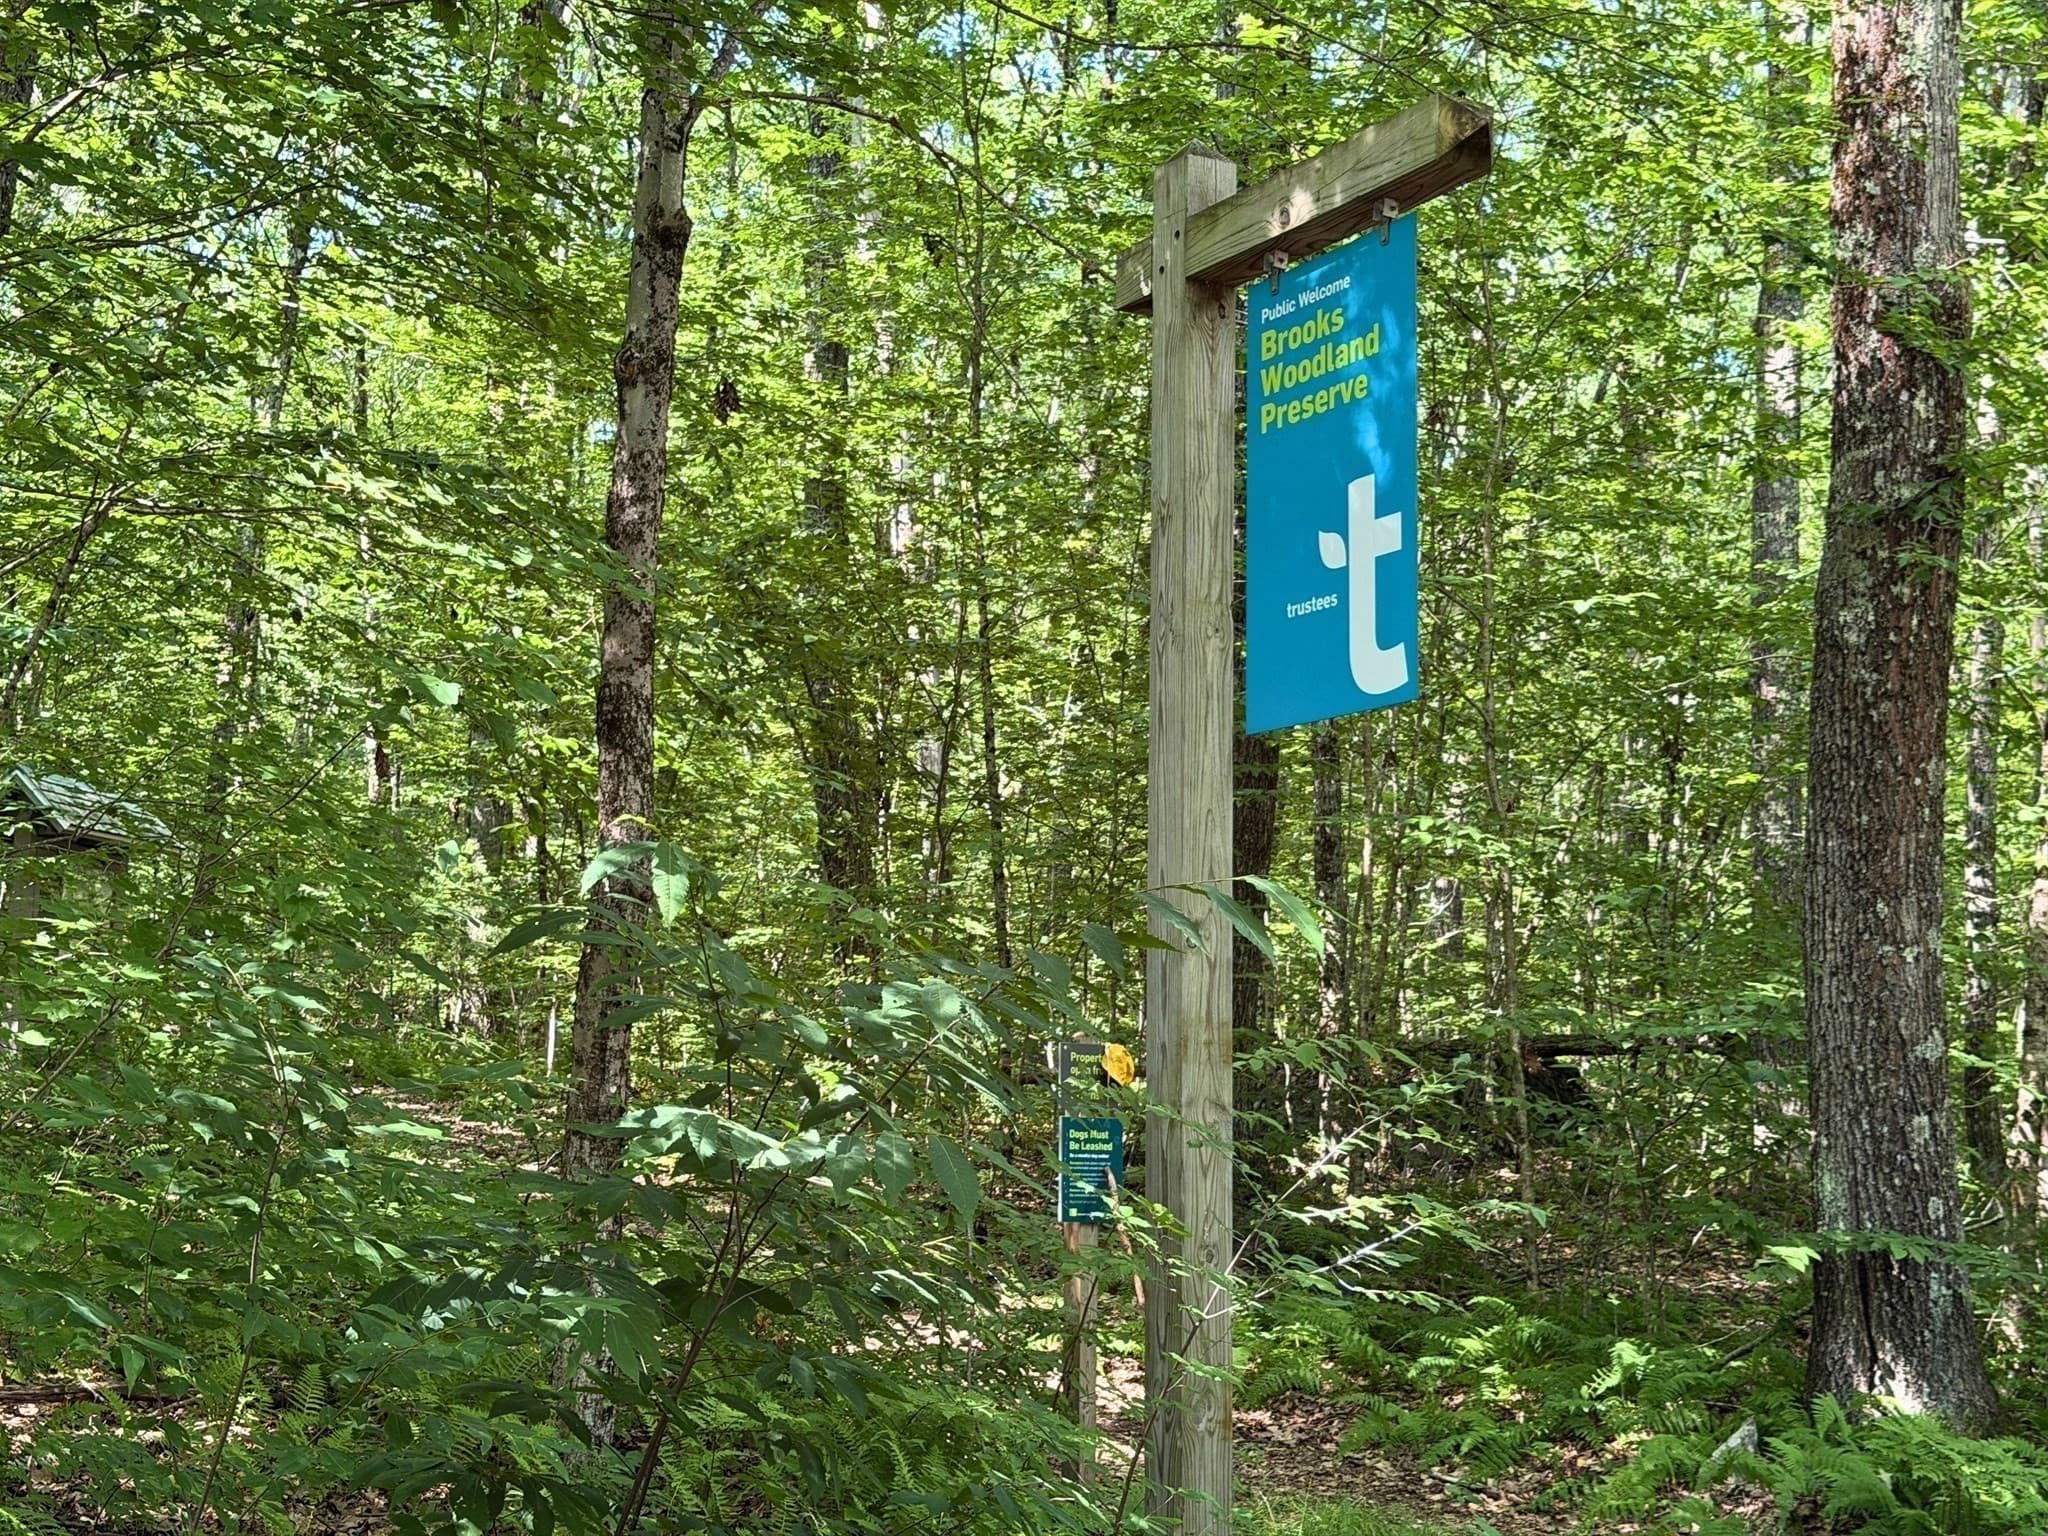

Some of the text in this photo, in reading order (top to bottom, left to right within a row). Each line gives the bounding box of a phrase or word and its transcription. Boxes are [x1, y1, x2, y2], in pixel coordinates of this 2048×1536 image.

[1262, 276, 1351, 324] Public Welcome
[1261, 307, 1344, 361] Brooks
[1260, 323, 1380, 397] Woodland
[1261, 373, 1368, 434] Preserve
[1286, 592, 1338, 618] trustees
[1070, 1052, 1102, 1064] Propert
[1069, 1129, 1109, 1140] Dogs Must
[1069, 1141, 1112, 1150] Be Leashed
